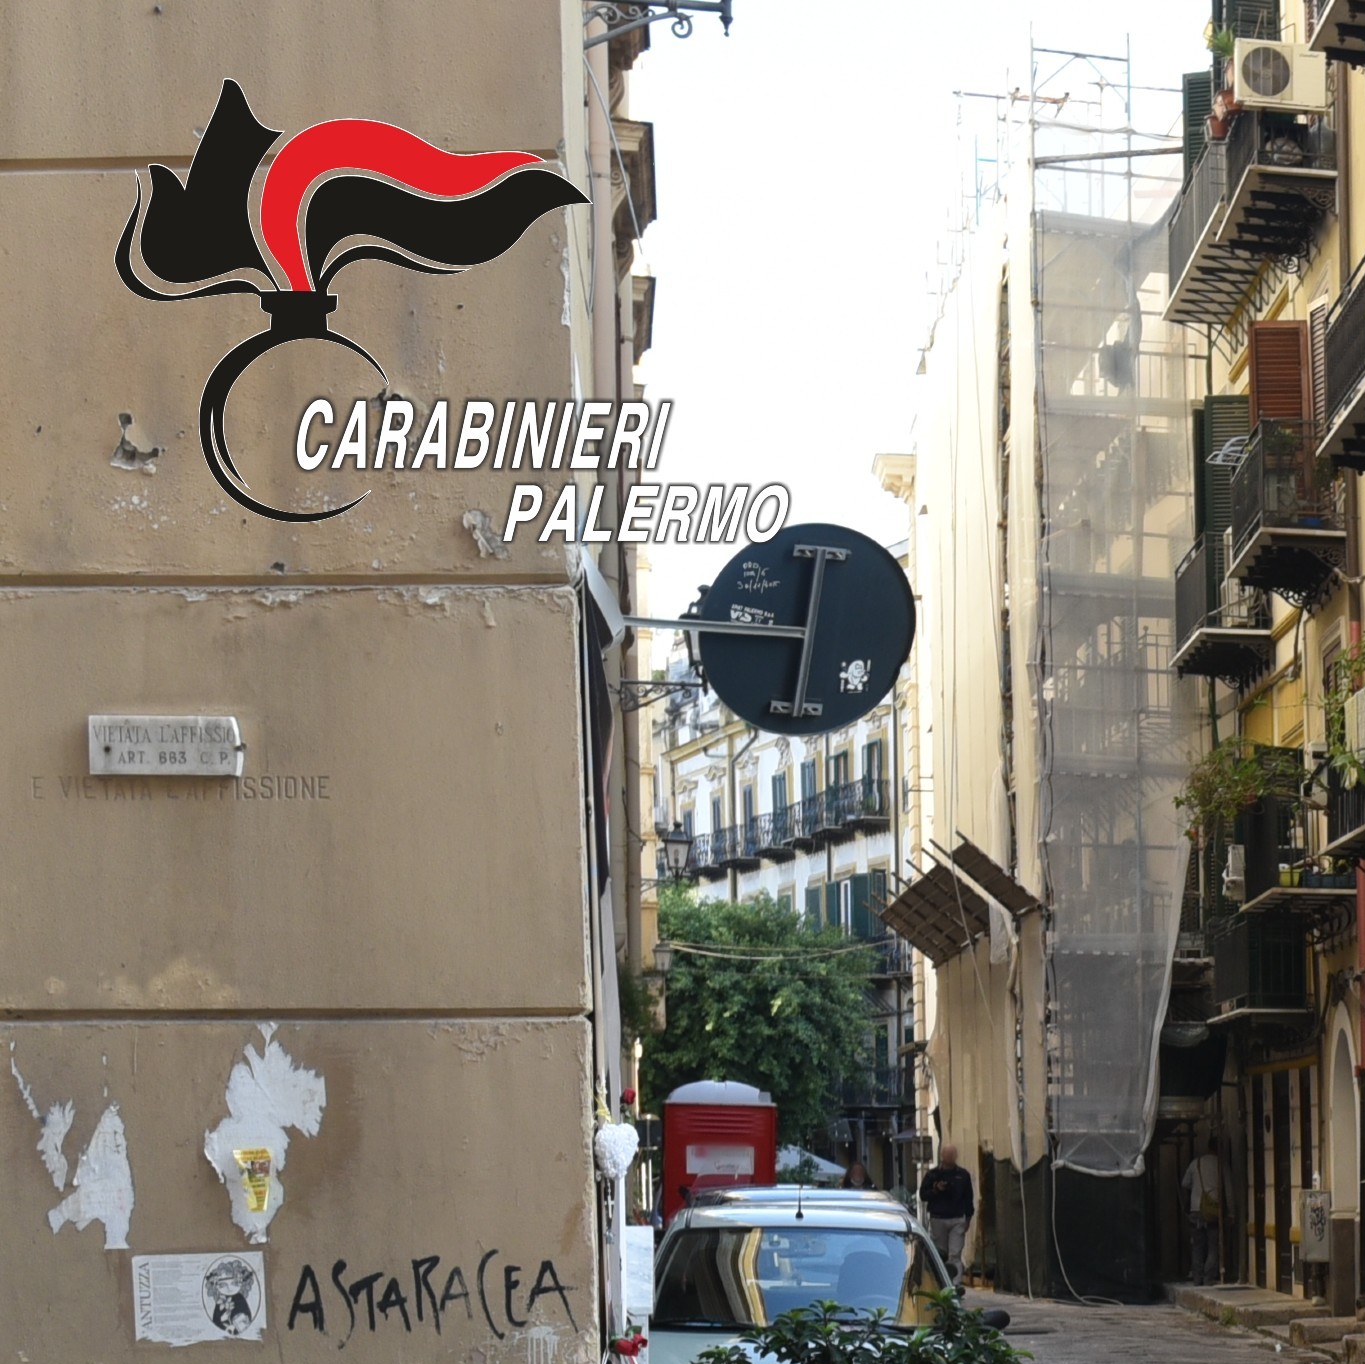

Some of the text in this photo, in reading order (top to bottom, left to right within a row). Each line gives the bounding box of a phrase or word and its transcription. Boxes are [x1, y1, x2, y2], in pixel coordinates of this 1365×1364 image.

[93, 725, 151, 744] VIETATA
[118, 751, 150, 766] ART.
[138, 1261, 152, 1331] ANTUZZA
[287, 1249, 579, 1350] ASTARACEA
